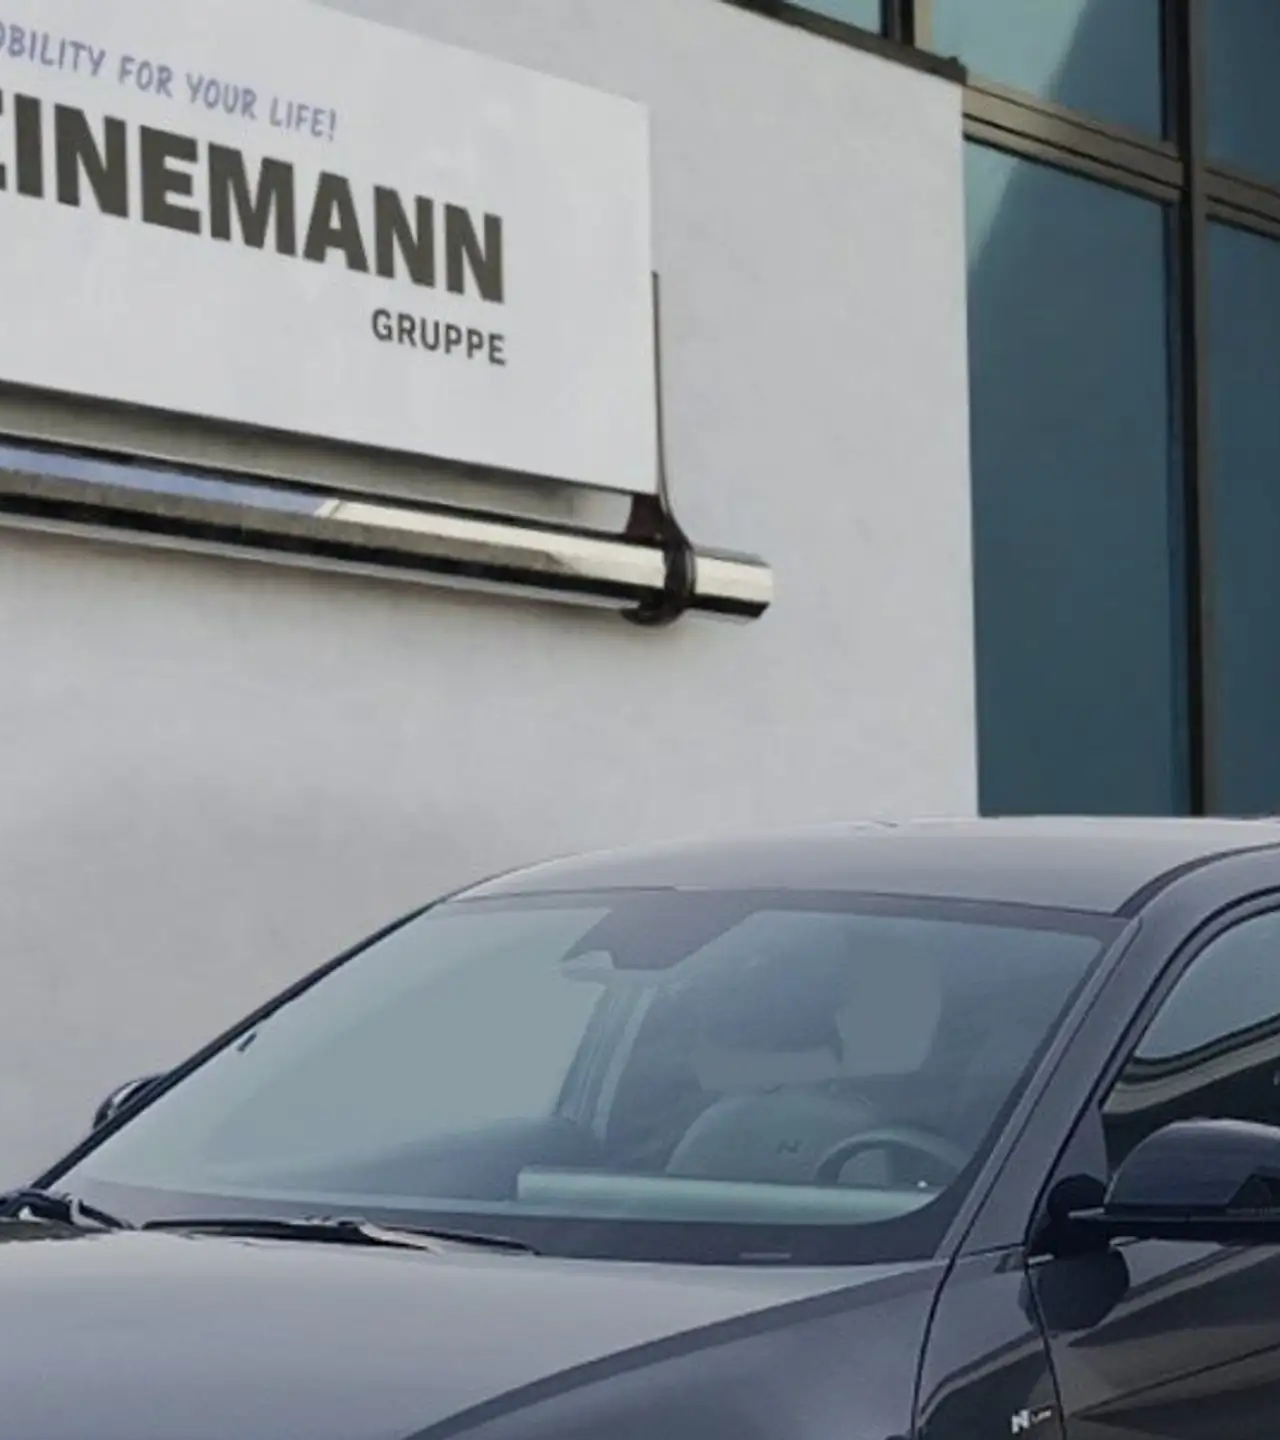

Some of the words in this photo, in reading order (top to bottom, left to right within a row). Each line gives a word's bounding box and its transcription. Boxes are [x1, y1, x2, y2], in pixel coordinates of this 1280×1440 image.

[118, 55, 174, 99] FOR
[185, 73, 258, 120] YOUR
[269, 97, 337, 141] LIFE!
[371, 308, 507, 366] GRUPPE
